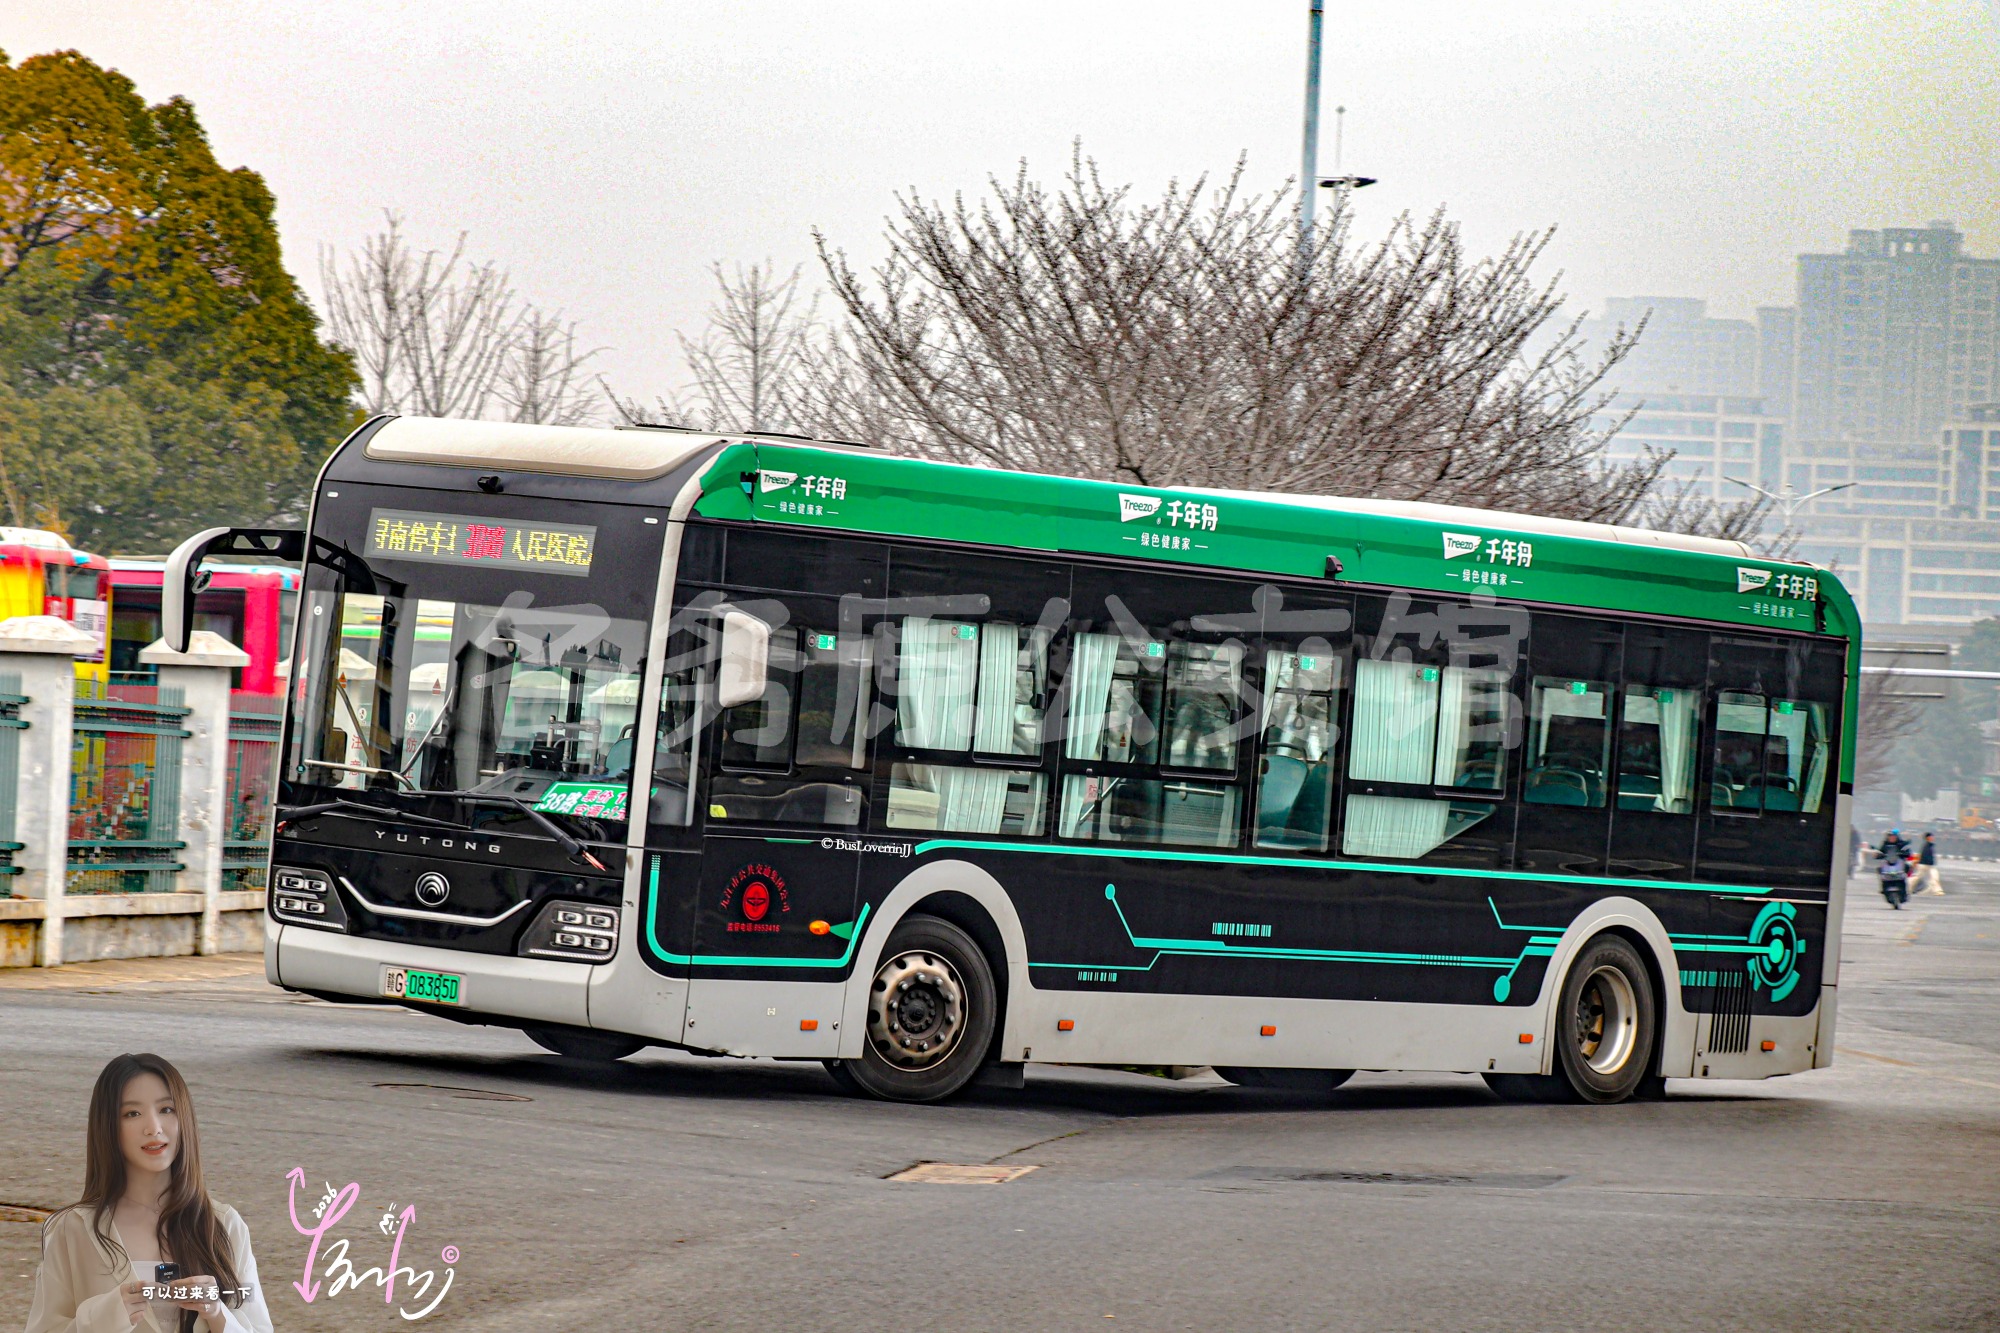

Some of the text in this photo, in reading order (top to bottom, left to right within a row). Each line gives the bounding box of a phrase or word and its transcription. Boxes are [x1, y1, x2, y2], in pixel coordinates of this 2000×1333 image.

[800, 475, 847, 500] 千年舟
[779, 501, 824, 516] 绿色健康家
[1123, 499, 1154, 512] Treezo
[1166, 500, 1218, 531] 千年舟
[512, 529, 593, 566] 人民医院
[1140, 532, 1191, 550] 绿色健康家
[1446, 537, 1474, 550] Treezo
[1485, 538, 1533, 568] 千年舟
[1462, 568, 1508, 586] 绿色健康家
[1775, 573, 1819, 602] 千年舟
[375, 829, 501, 854] YUTONG
